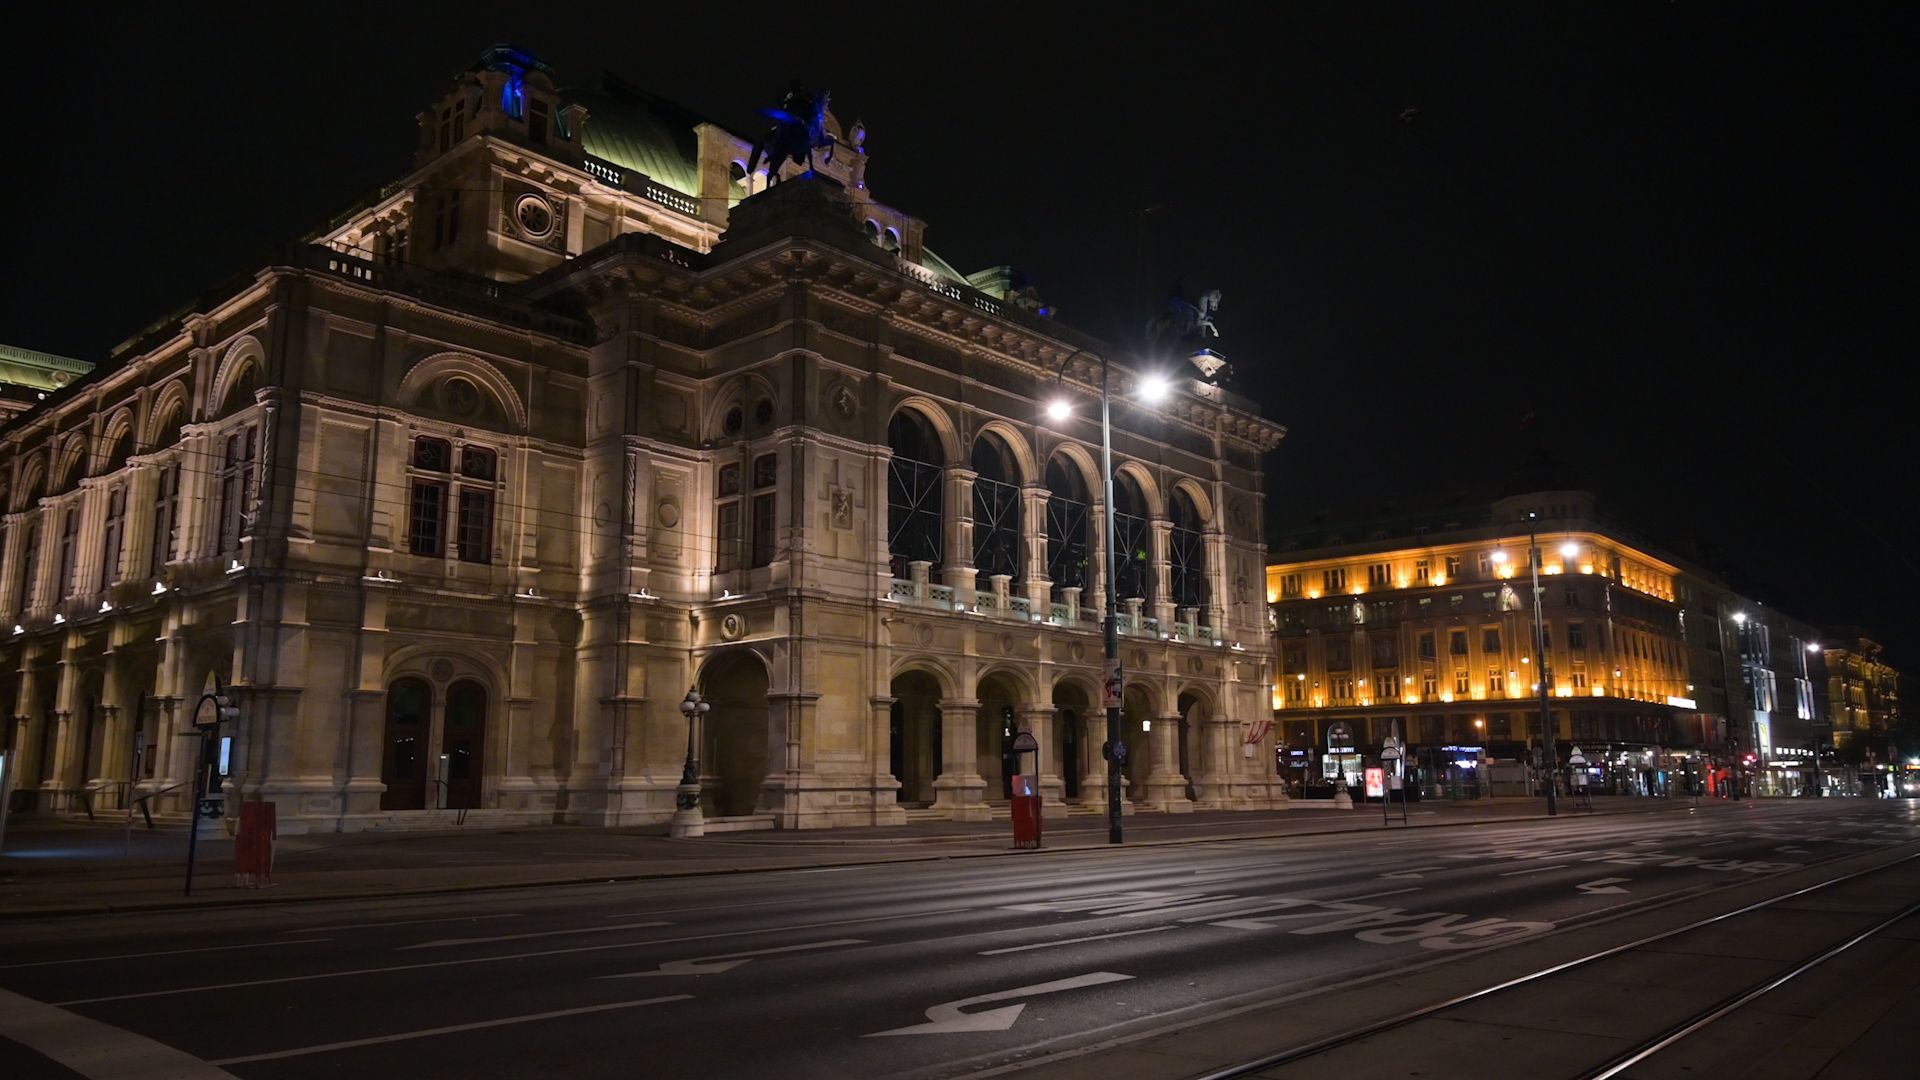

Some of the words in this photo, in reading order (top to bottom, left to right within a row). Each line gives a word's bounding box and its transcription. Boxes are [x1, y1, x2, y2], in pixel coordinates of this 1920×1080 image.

[1603, 854, 1804, 873] GRAZ
[997, 891, 1317, 922] LINZ
[1207, 903, 1556, 951] GRAZ
